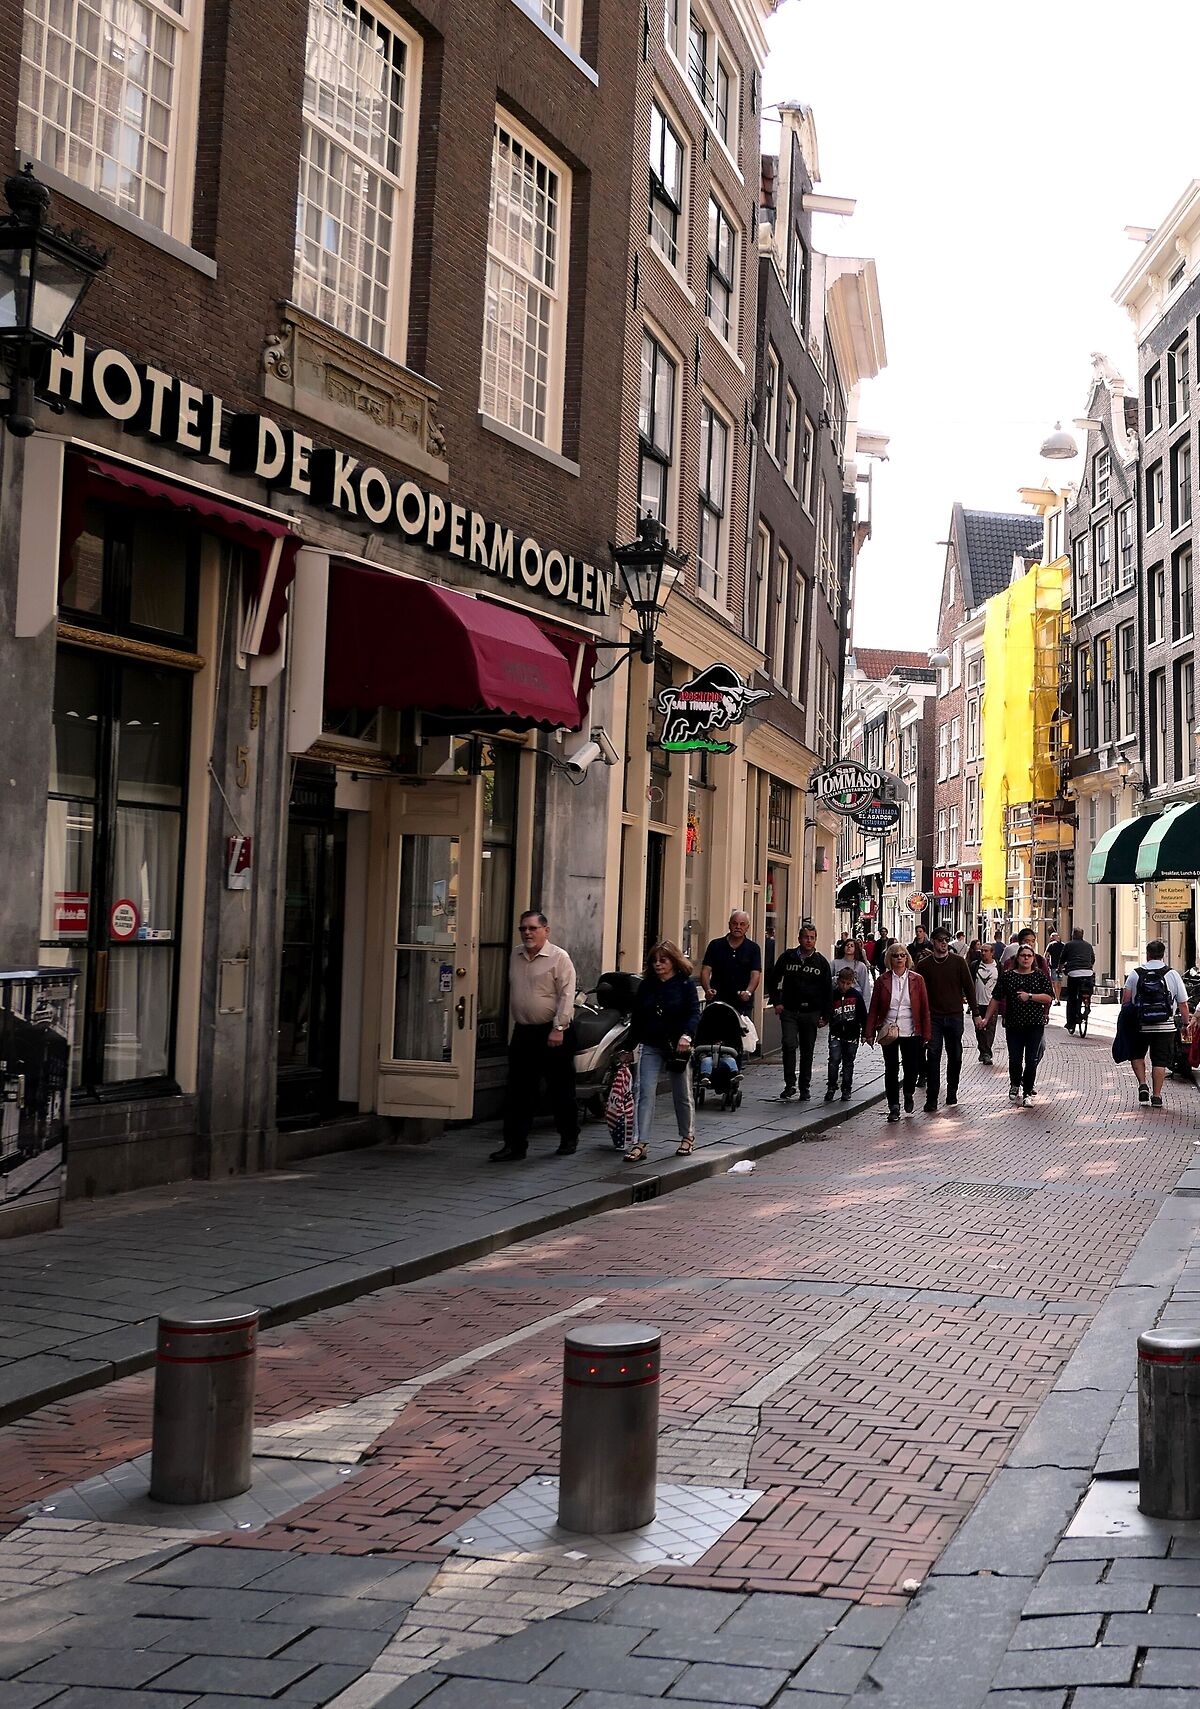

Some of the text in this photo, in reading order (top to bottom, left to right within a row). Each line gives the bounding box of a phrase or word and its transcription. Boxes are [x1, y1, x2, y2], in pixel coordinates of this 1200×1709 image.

[48, 331, 613, 616] HOTEL DE KOOPERMOOLEN
[672, 701, 719, 711] SAN THOMAS
[236, 744, 250, 789] 5
[835, 767, 856, 775] San
[810, 771, 881, 800] TOMMASO
